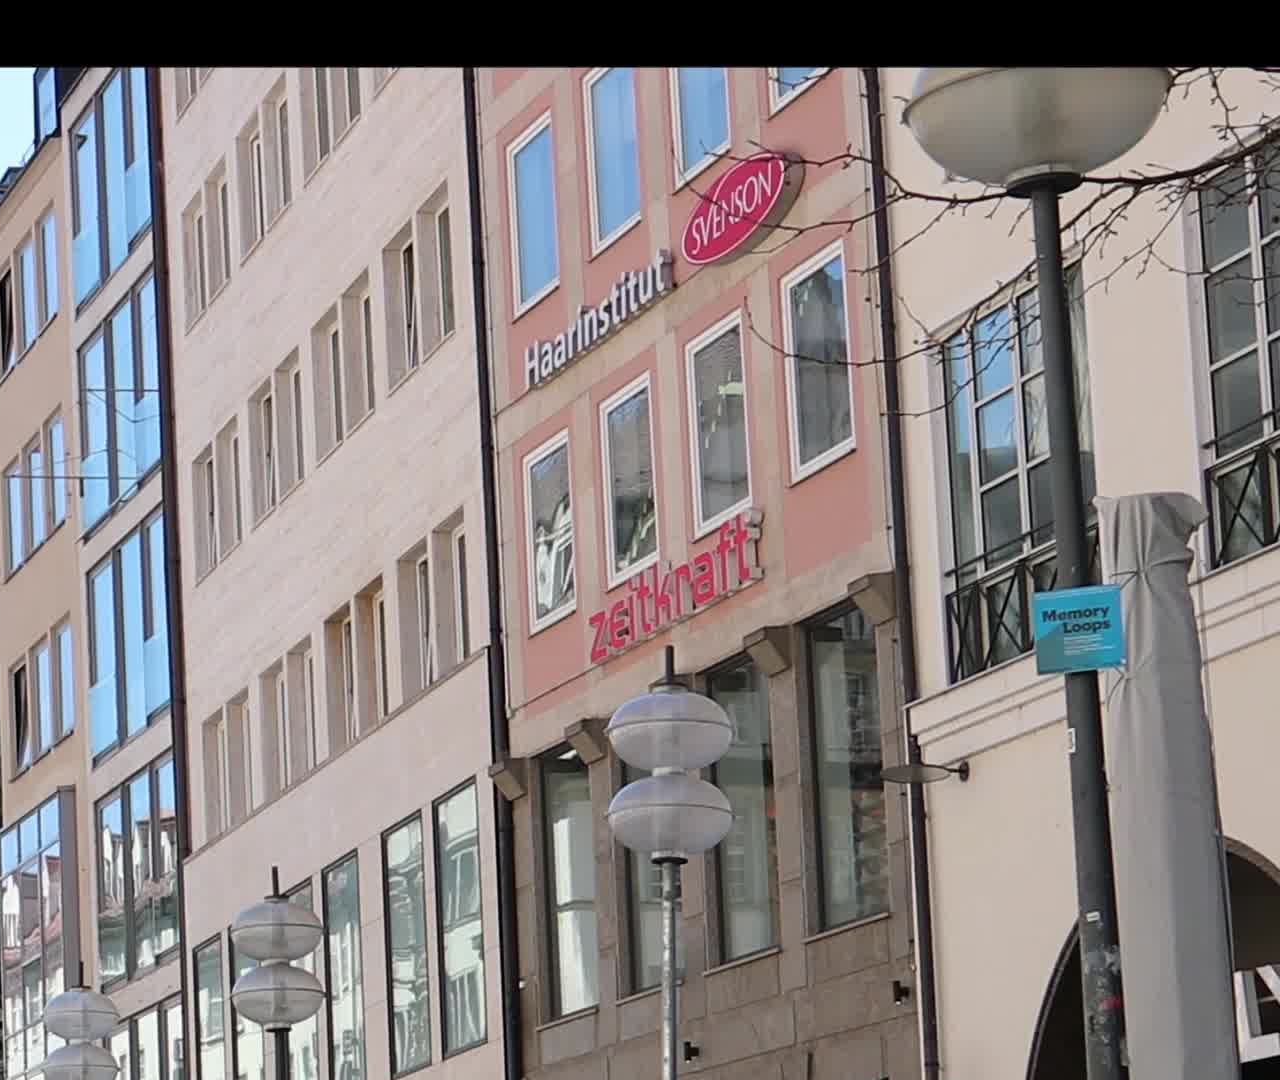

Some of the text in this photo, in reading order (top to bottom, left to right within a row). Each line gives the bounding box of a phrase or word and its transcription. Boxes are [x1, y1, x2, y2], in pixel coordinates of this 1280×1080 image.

[691, 162, 774, 255] SVENSON
[524, 248, 668, 385] Haarinstitut
[589, 512, 754, 664] zeitkraft
[1041, 605, 1110, 623] Memory
[1063, 619, 1111, 634] Loops
